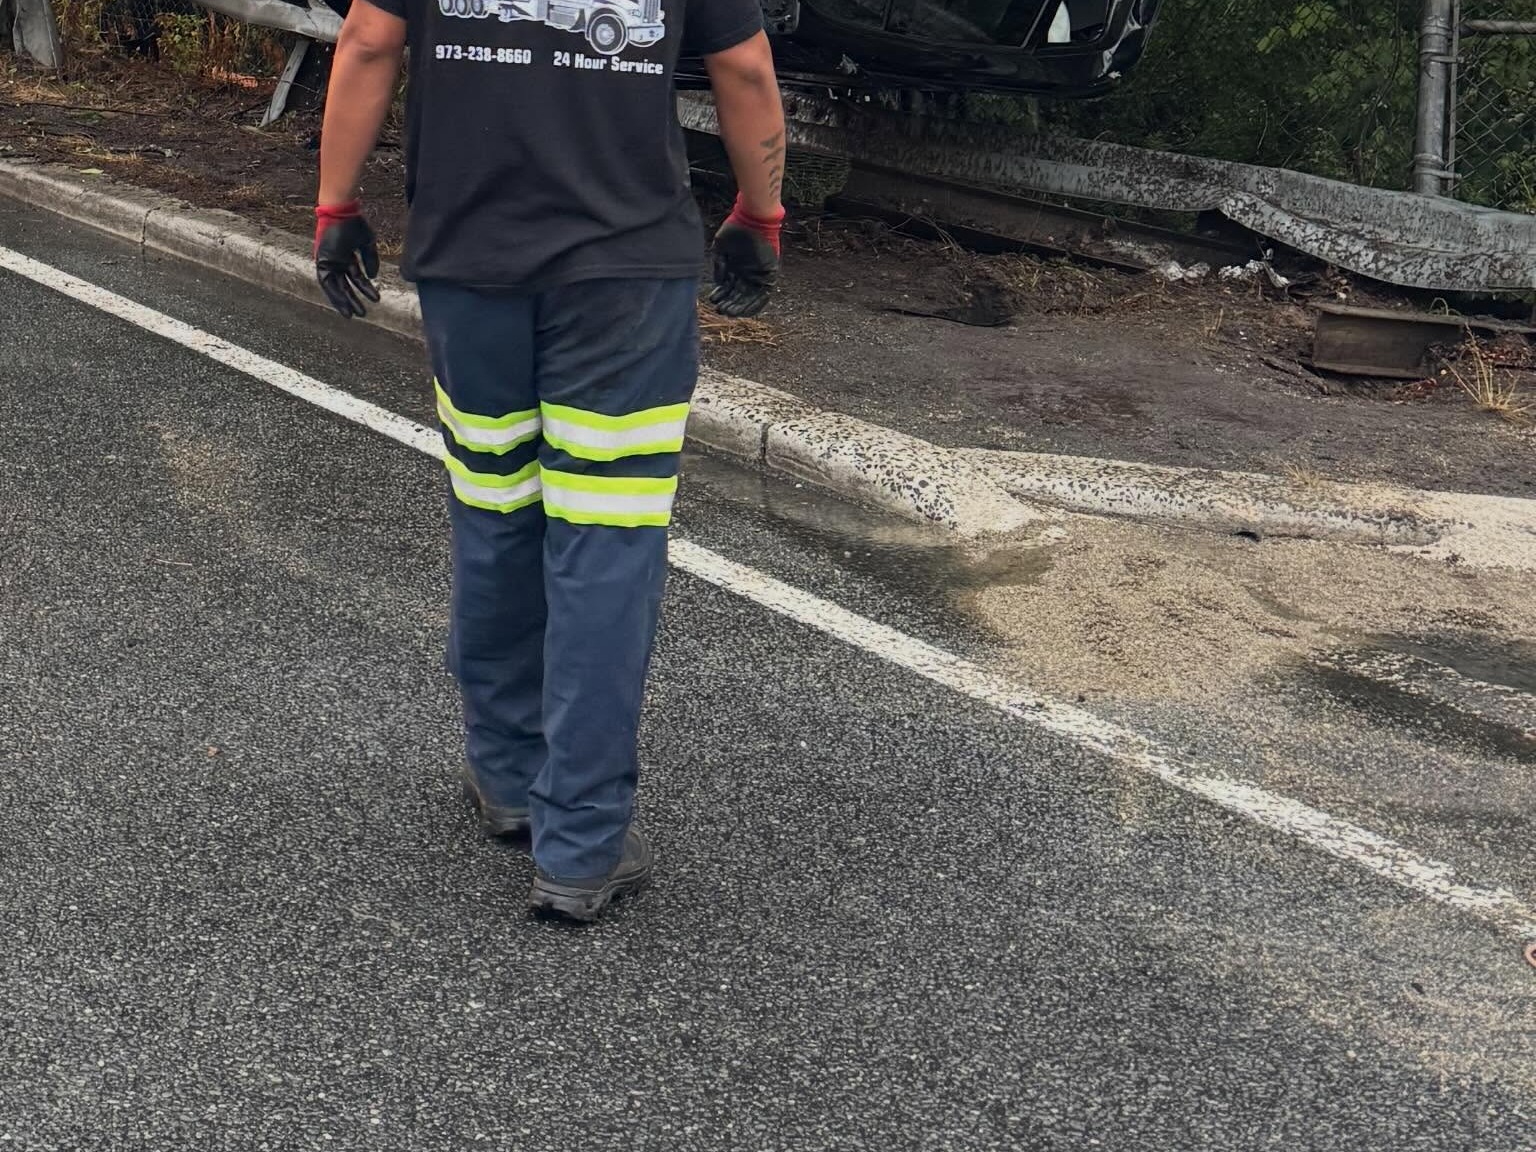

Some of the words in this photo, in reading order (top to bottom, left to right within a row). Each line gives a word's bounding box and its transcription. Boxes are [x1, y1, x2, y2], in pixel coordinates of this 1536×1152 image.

[435, 44, 532, 65] 973-238-8660
[553, 50, 571, 67] 24
[574, 53, 607, 70] Hour
[611, 55, 664, 75] Service
